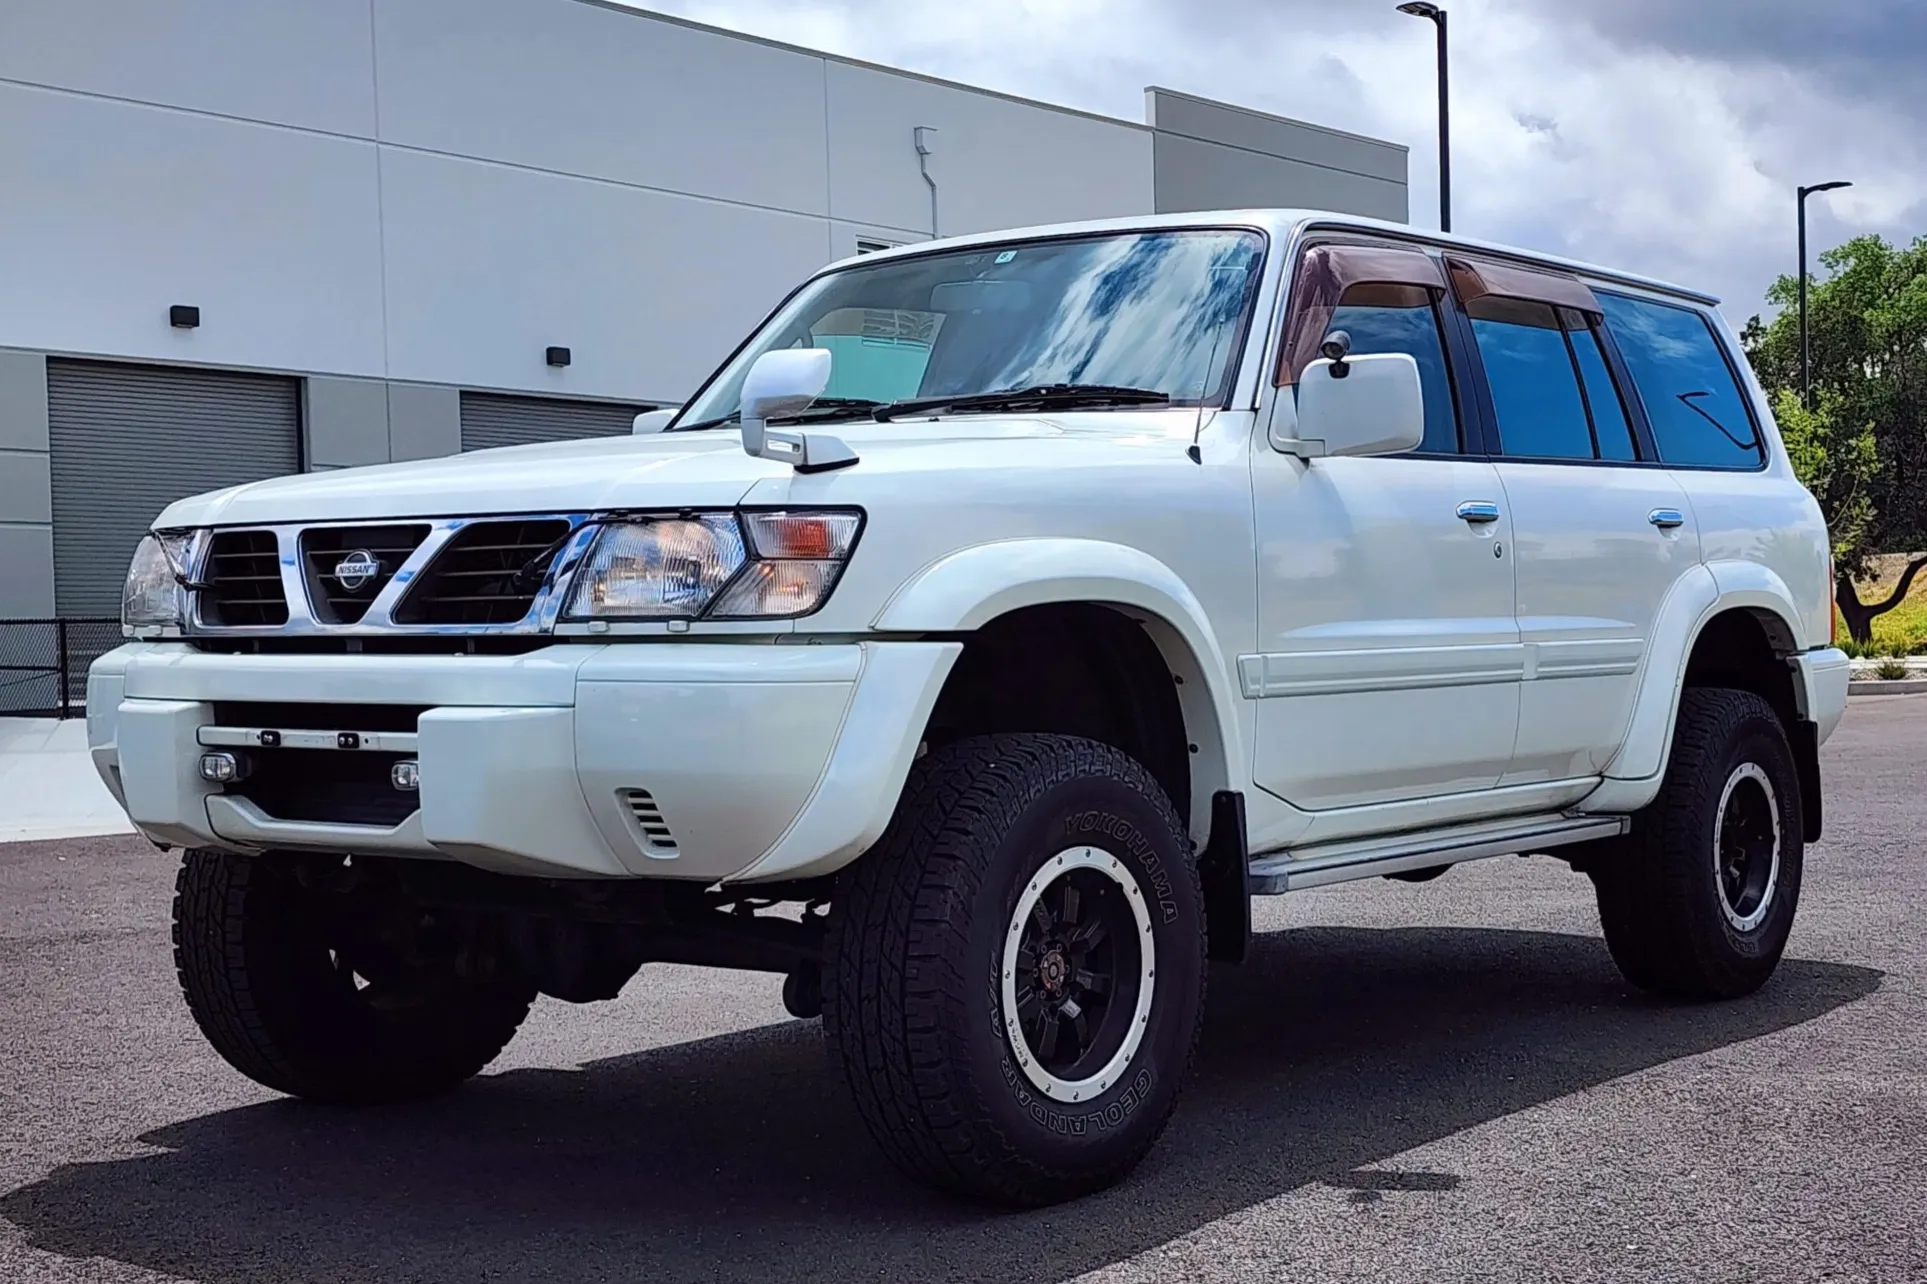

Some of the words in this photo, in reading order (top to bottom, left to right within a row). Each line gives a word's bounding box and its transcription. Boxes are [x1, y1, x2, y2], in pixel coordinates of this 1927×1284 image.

[338, 565, 370, 574] NISSAN
[1064, 810, 1179, 924] YOKOHAMA
[1001, 1056, 1152, 1135] GEOLANDAR
